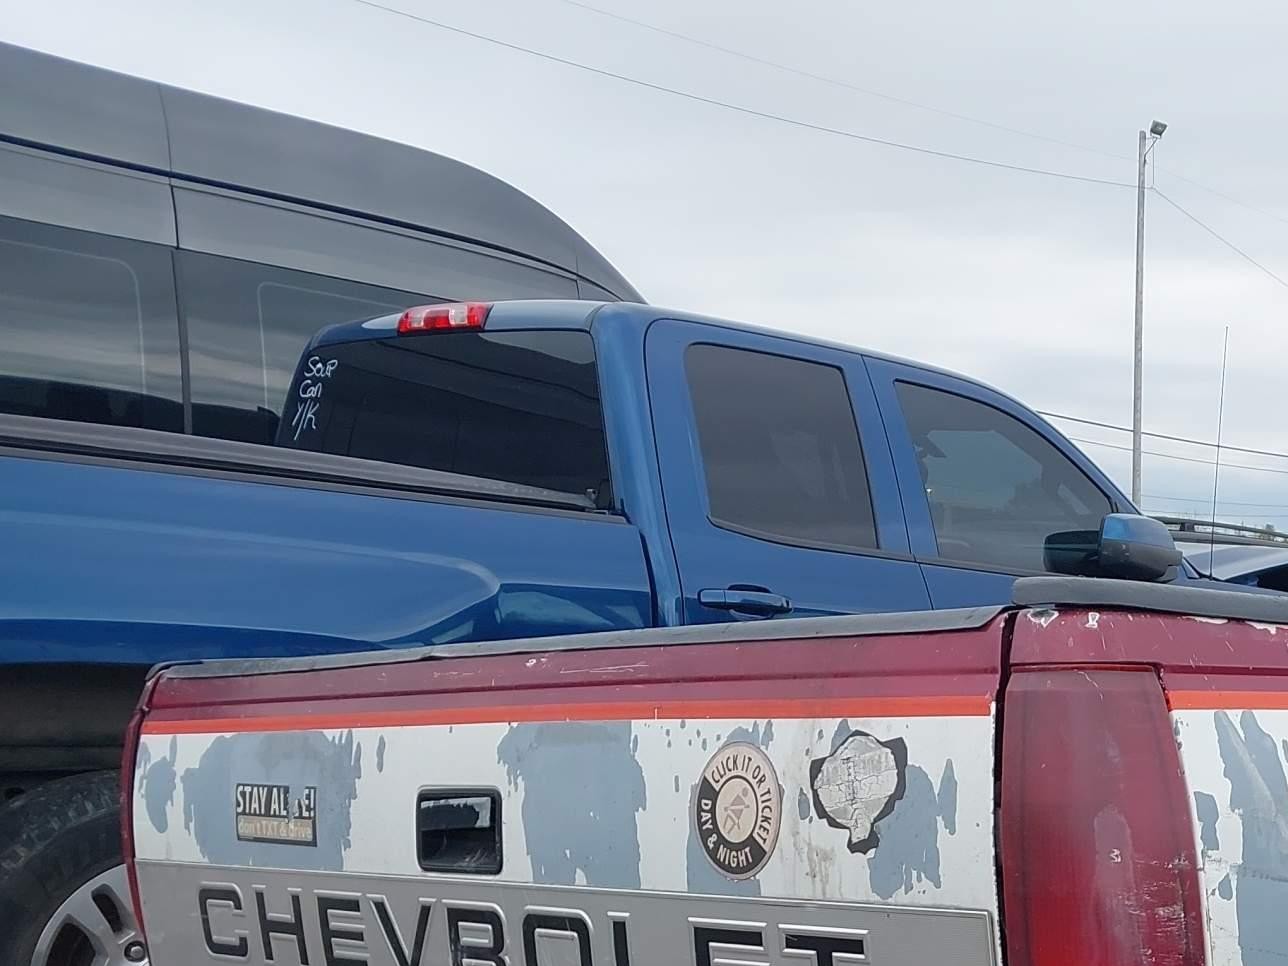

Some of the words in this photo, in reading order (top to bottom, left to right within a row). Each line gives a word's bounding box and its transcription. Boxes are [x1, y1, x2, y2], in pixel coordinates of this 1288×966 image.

[711, 754, 739, 783] CLICK
[741, 754, 753, 773] IT
[752, 765, 767, 788] OR
[236, 785, 268, 815] STAY
[270, 787, 314, 817] ALE!
[758, 788, 772, 844] TICKET
[701, 799, 713, 830] DAY
[707, 833, 718, 850] &
[717, 844, 753, 868] NIGHT
